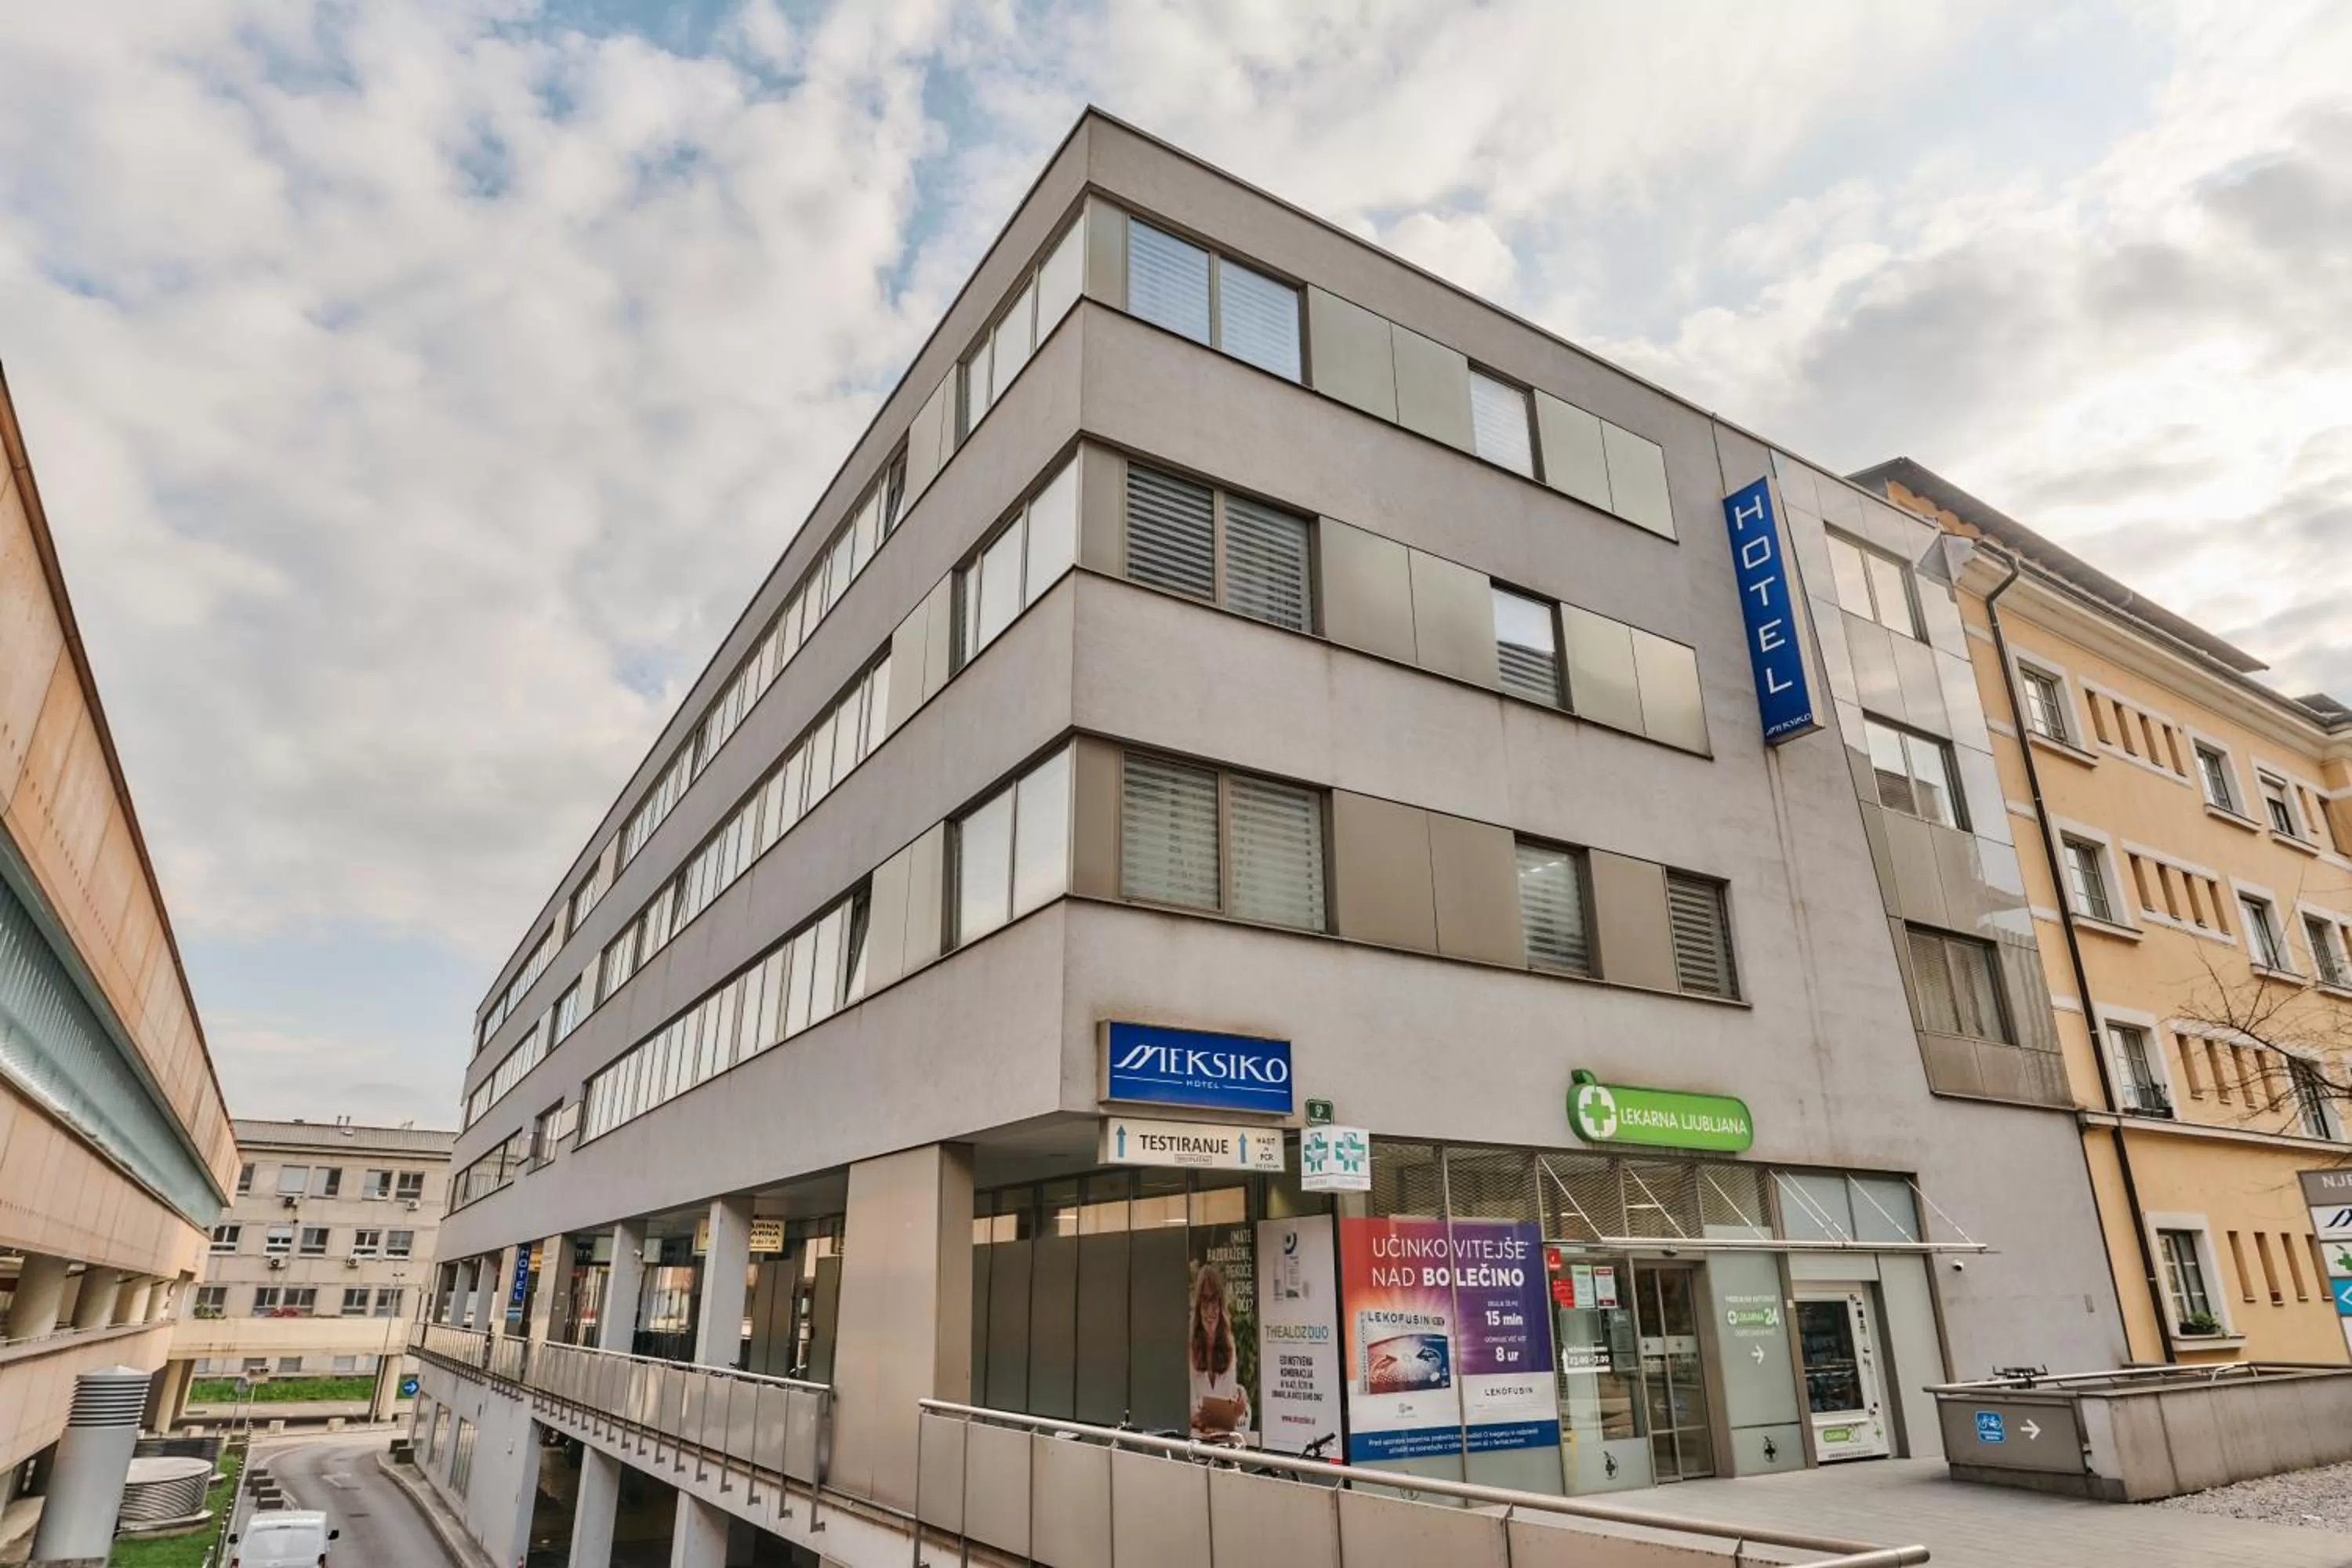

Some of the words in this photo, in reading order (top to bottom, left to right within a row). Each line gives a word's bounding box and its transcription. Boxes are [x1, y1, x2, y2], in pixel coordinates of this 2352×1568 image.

[1734, 495, 1793, 695] HOTEL
[1112, 1044, 1288, 1083] MEKSIKO
[1186, 1080, 1220, 1089] HOTEL
[1621, 1107, 1679, 1129] LEKARNA
[1681, 1113, 1748, 1135] LJUBLJANA
[1139, 1134, 1229, 1154] TESTIRANJE
[1261, 1153, 1274, 1162] PCR
[1230, 1229, 1252, 1243] IMATE
[514, 1249, 529, 1301] HOTEL
[1373, 1267, 1415, 1287] NAD
[1422, 1263, 1525, 1287] BOLEČINO
[1367, 1311, 1430, 1326] LEKOFUSIN
[1485, 1310, 1501, 1326] 15
[1502, 1312, 1523, 1326] min
[1495, 1346, 1504, 1363] 8
[1507, 1350, 1519, 1362] ur
[1484, 1386, 1534, 1397] LEKOFUSIN
